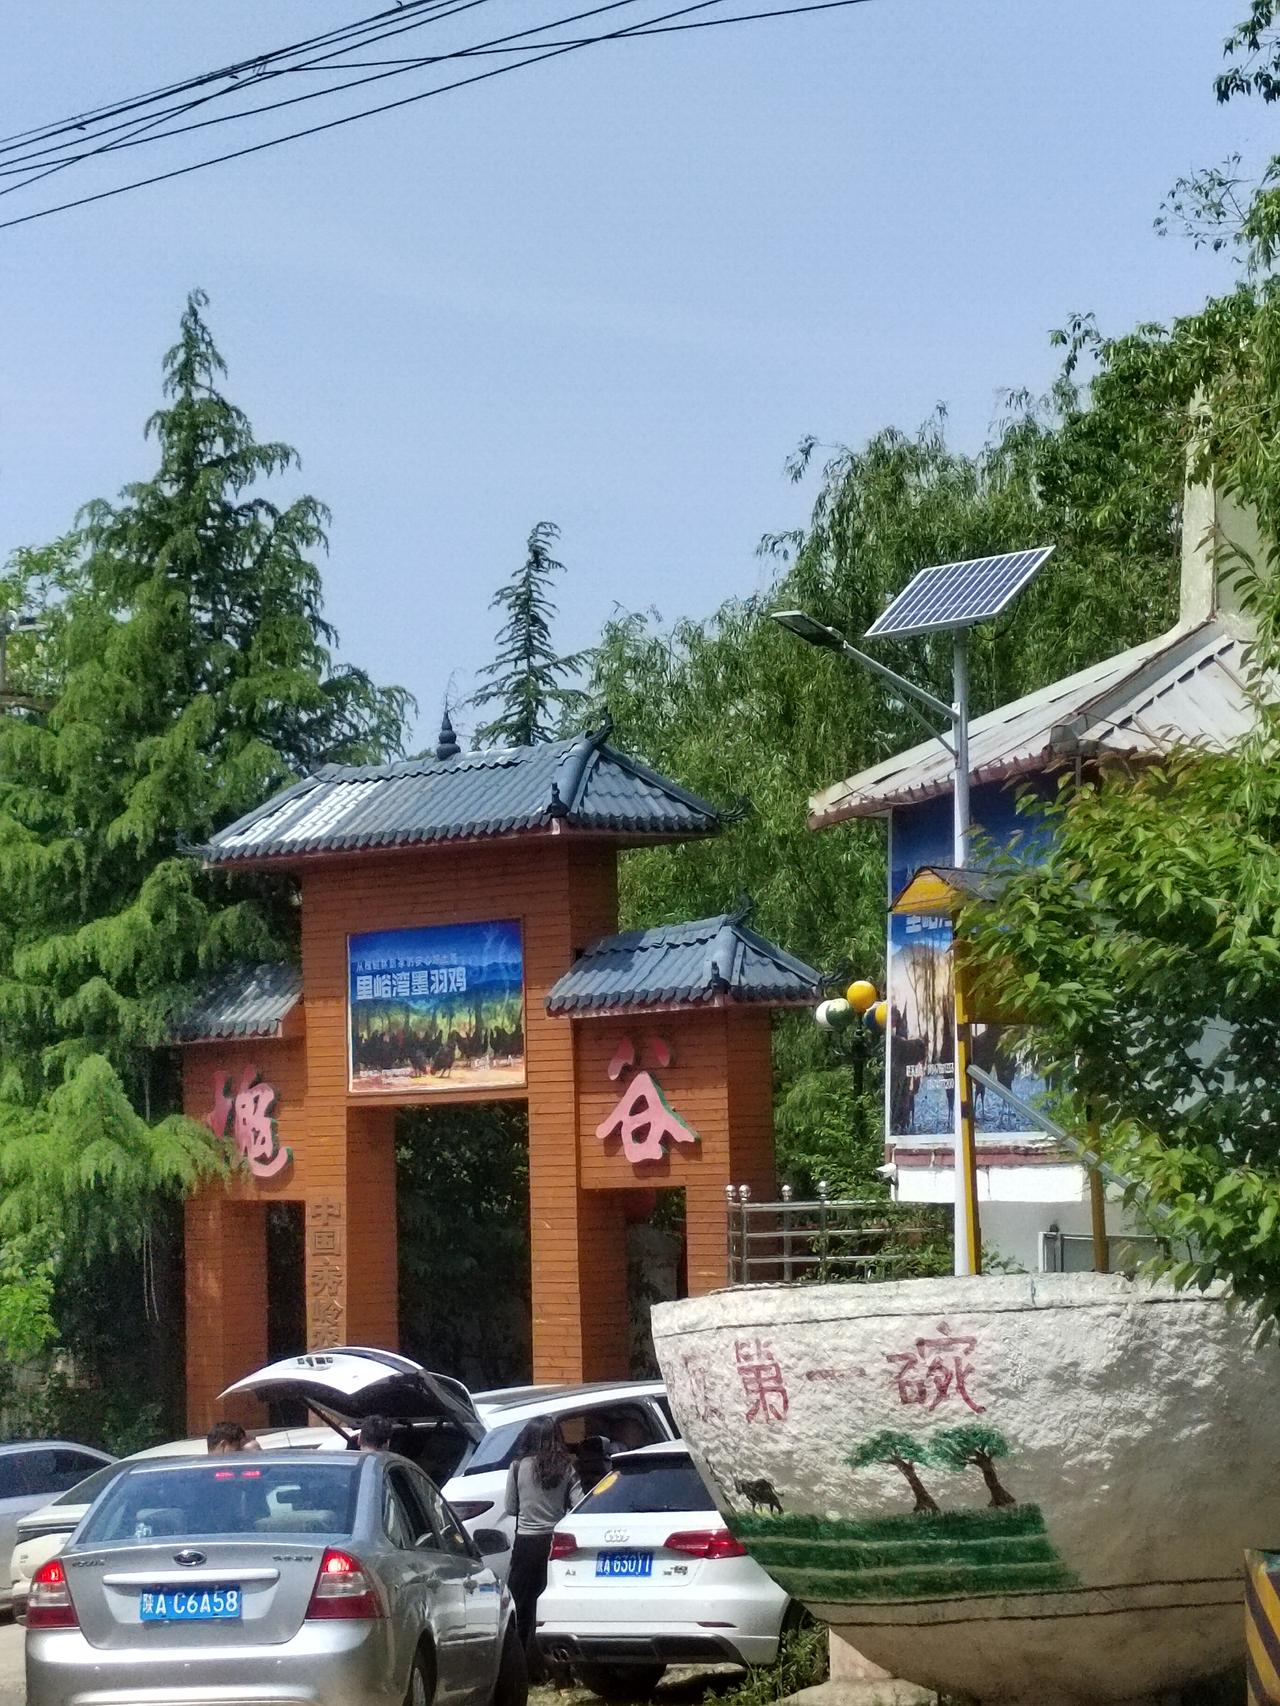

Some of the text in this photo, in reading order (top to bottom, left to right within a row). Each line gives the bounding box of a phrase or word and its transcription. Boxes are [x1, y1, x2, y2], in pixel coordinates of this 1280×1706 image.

[356, 966, 467, 1000] 里峪湾墨羽鸡
[595, 1036, 699, 1163] 谷
[662, 1320, 987, 1424] 第一碗
